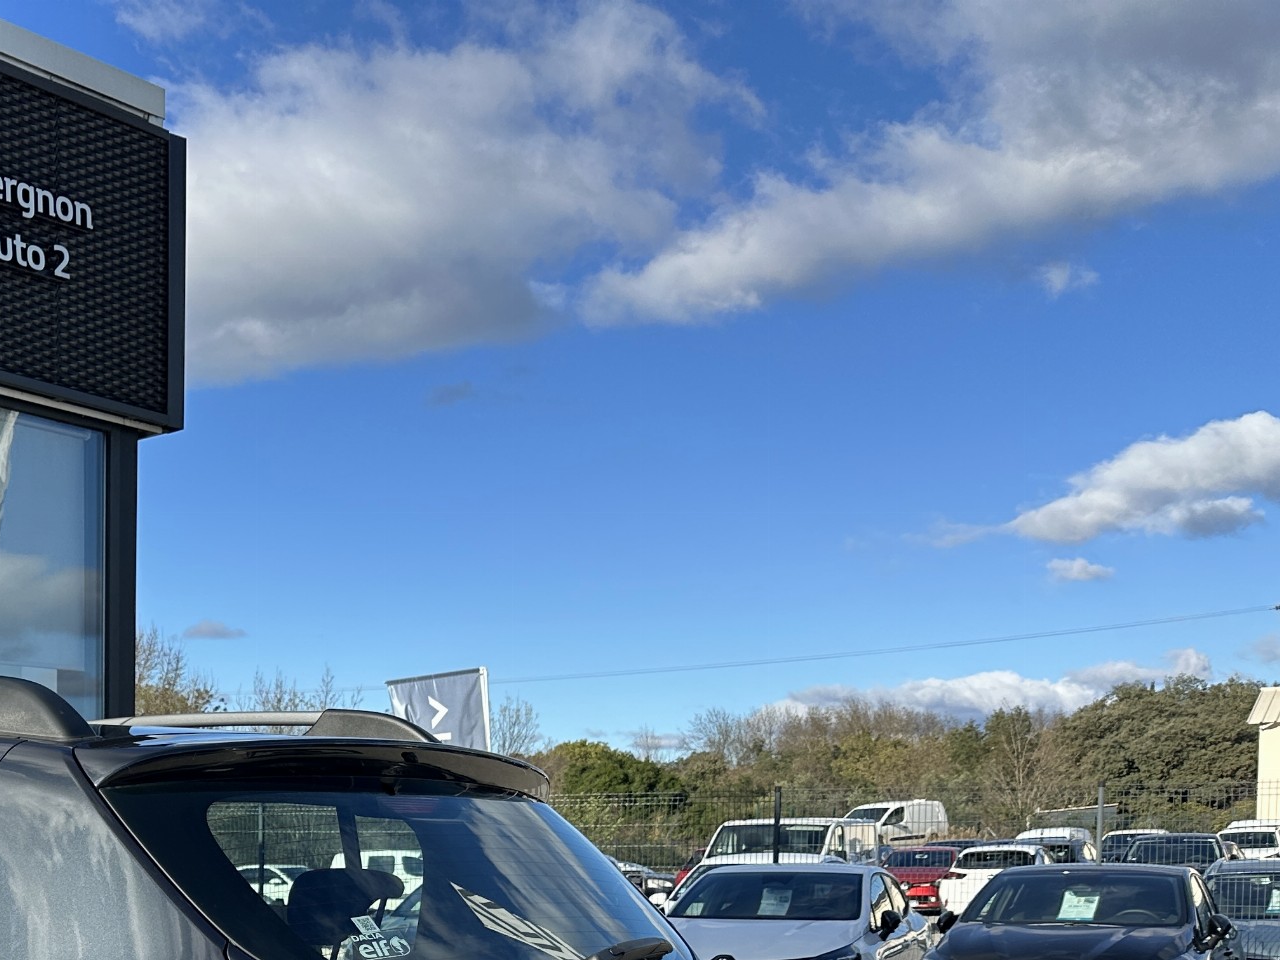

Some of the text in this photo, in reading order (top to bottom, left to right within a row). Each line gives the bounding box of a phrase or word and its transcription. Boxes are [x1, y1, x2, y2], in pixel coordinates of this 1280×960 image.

[53, 244, 71, 280] 2
[350, 933, 384, 942] DACIA
[359, 940, 391, 958] elf
